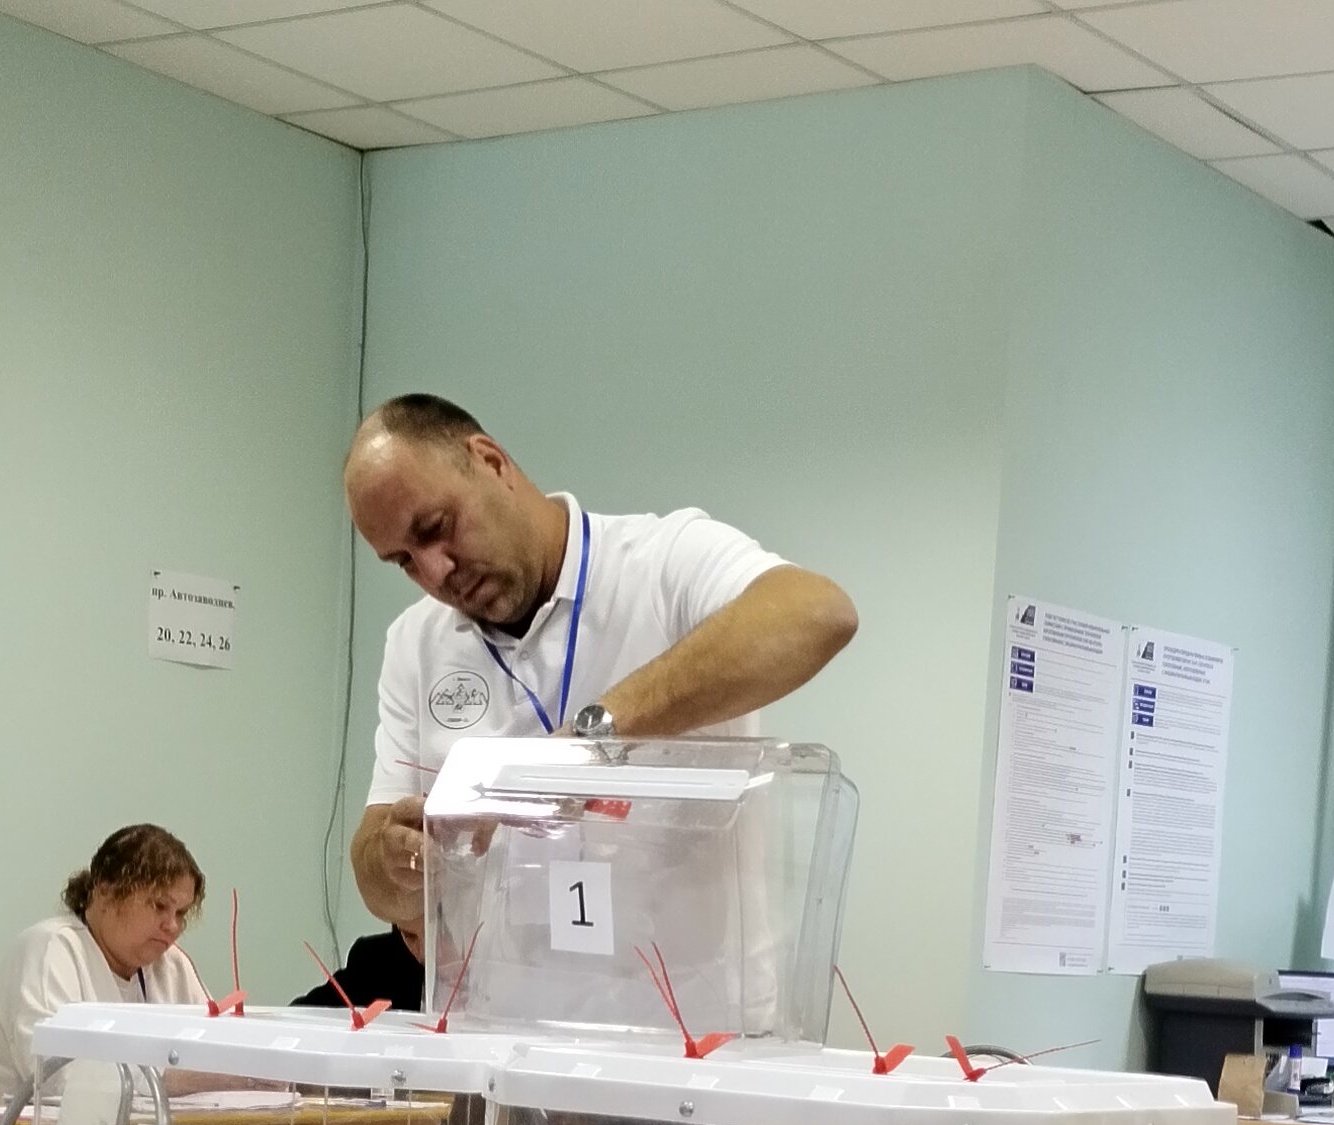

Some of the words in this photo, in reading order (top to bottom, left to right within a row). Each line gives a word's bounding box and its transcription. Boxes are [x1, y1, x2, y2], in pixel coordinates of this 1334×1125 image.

[152, 588, 166, 600] пр.
[157, 627, 174, 643] 20,
[179, 630, 196, 647] 22,
[200, 633, 215, 650] 24,
[219, 636, 230, 650] 26
[569, 881, 594, 927] 1
